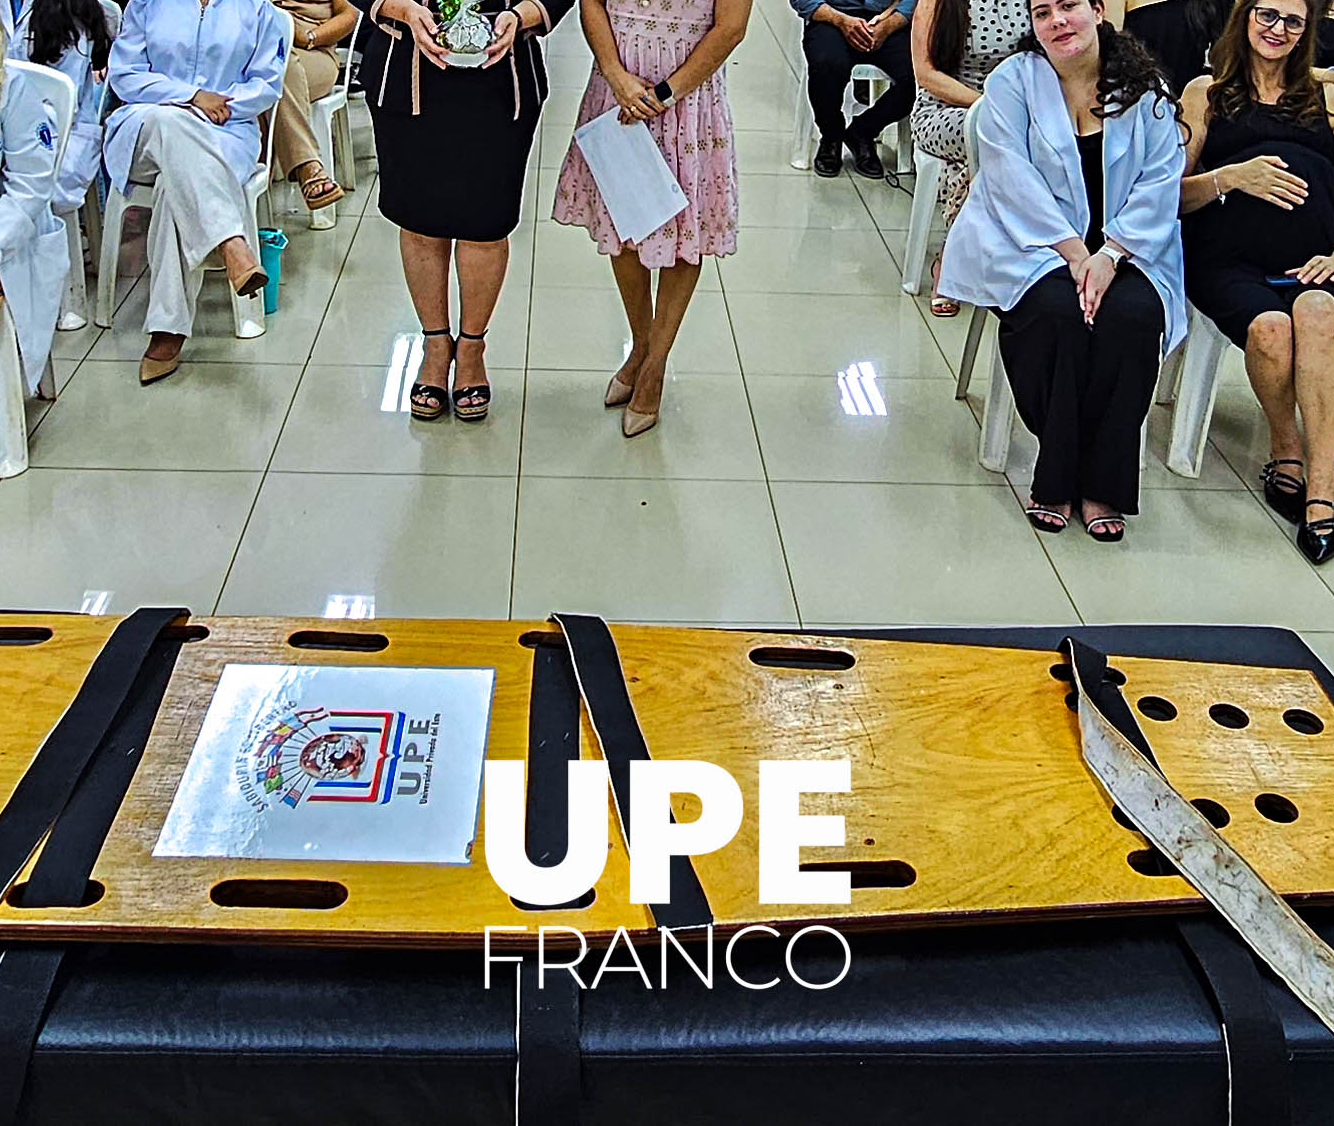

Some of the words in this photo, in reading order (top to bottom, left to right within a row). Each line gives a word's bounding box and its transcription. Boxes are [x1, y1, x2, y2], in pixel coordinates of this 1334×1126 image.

[397, 719, 431, 795] UPE
[425, 738, 437, 763] Privada
[419, 764, 433, 805] Universidad
